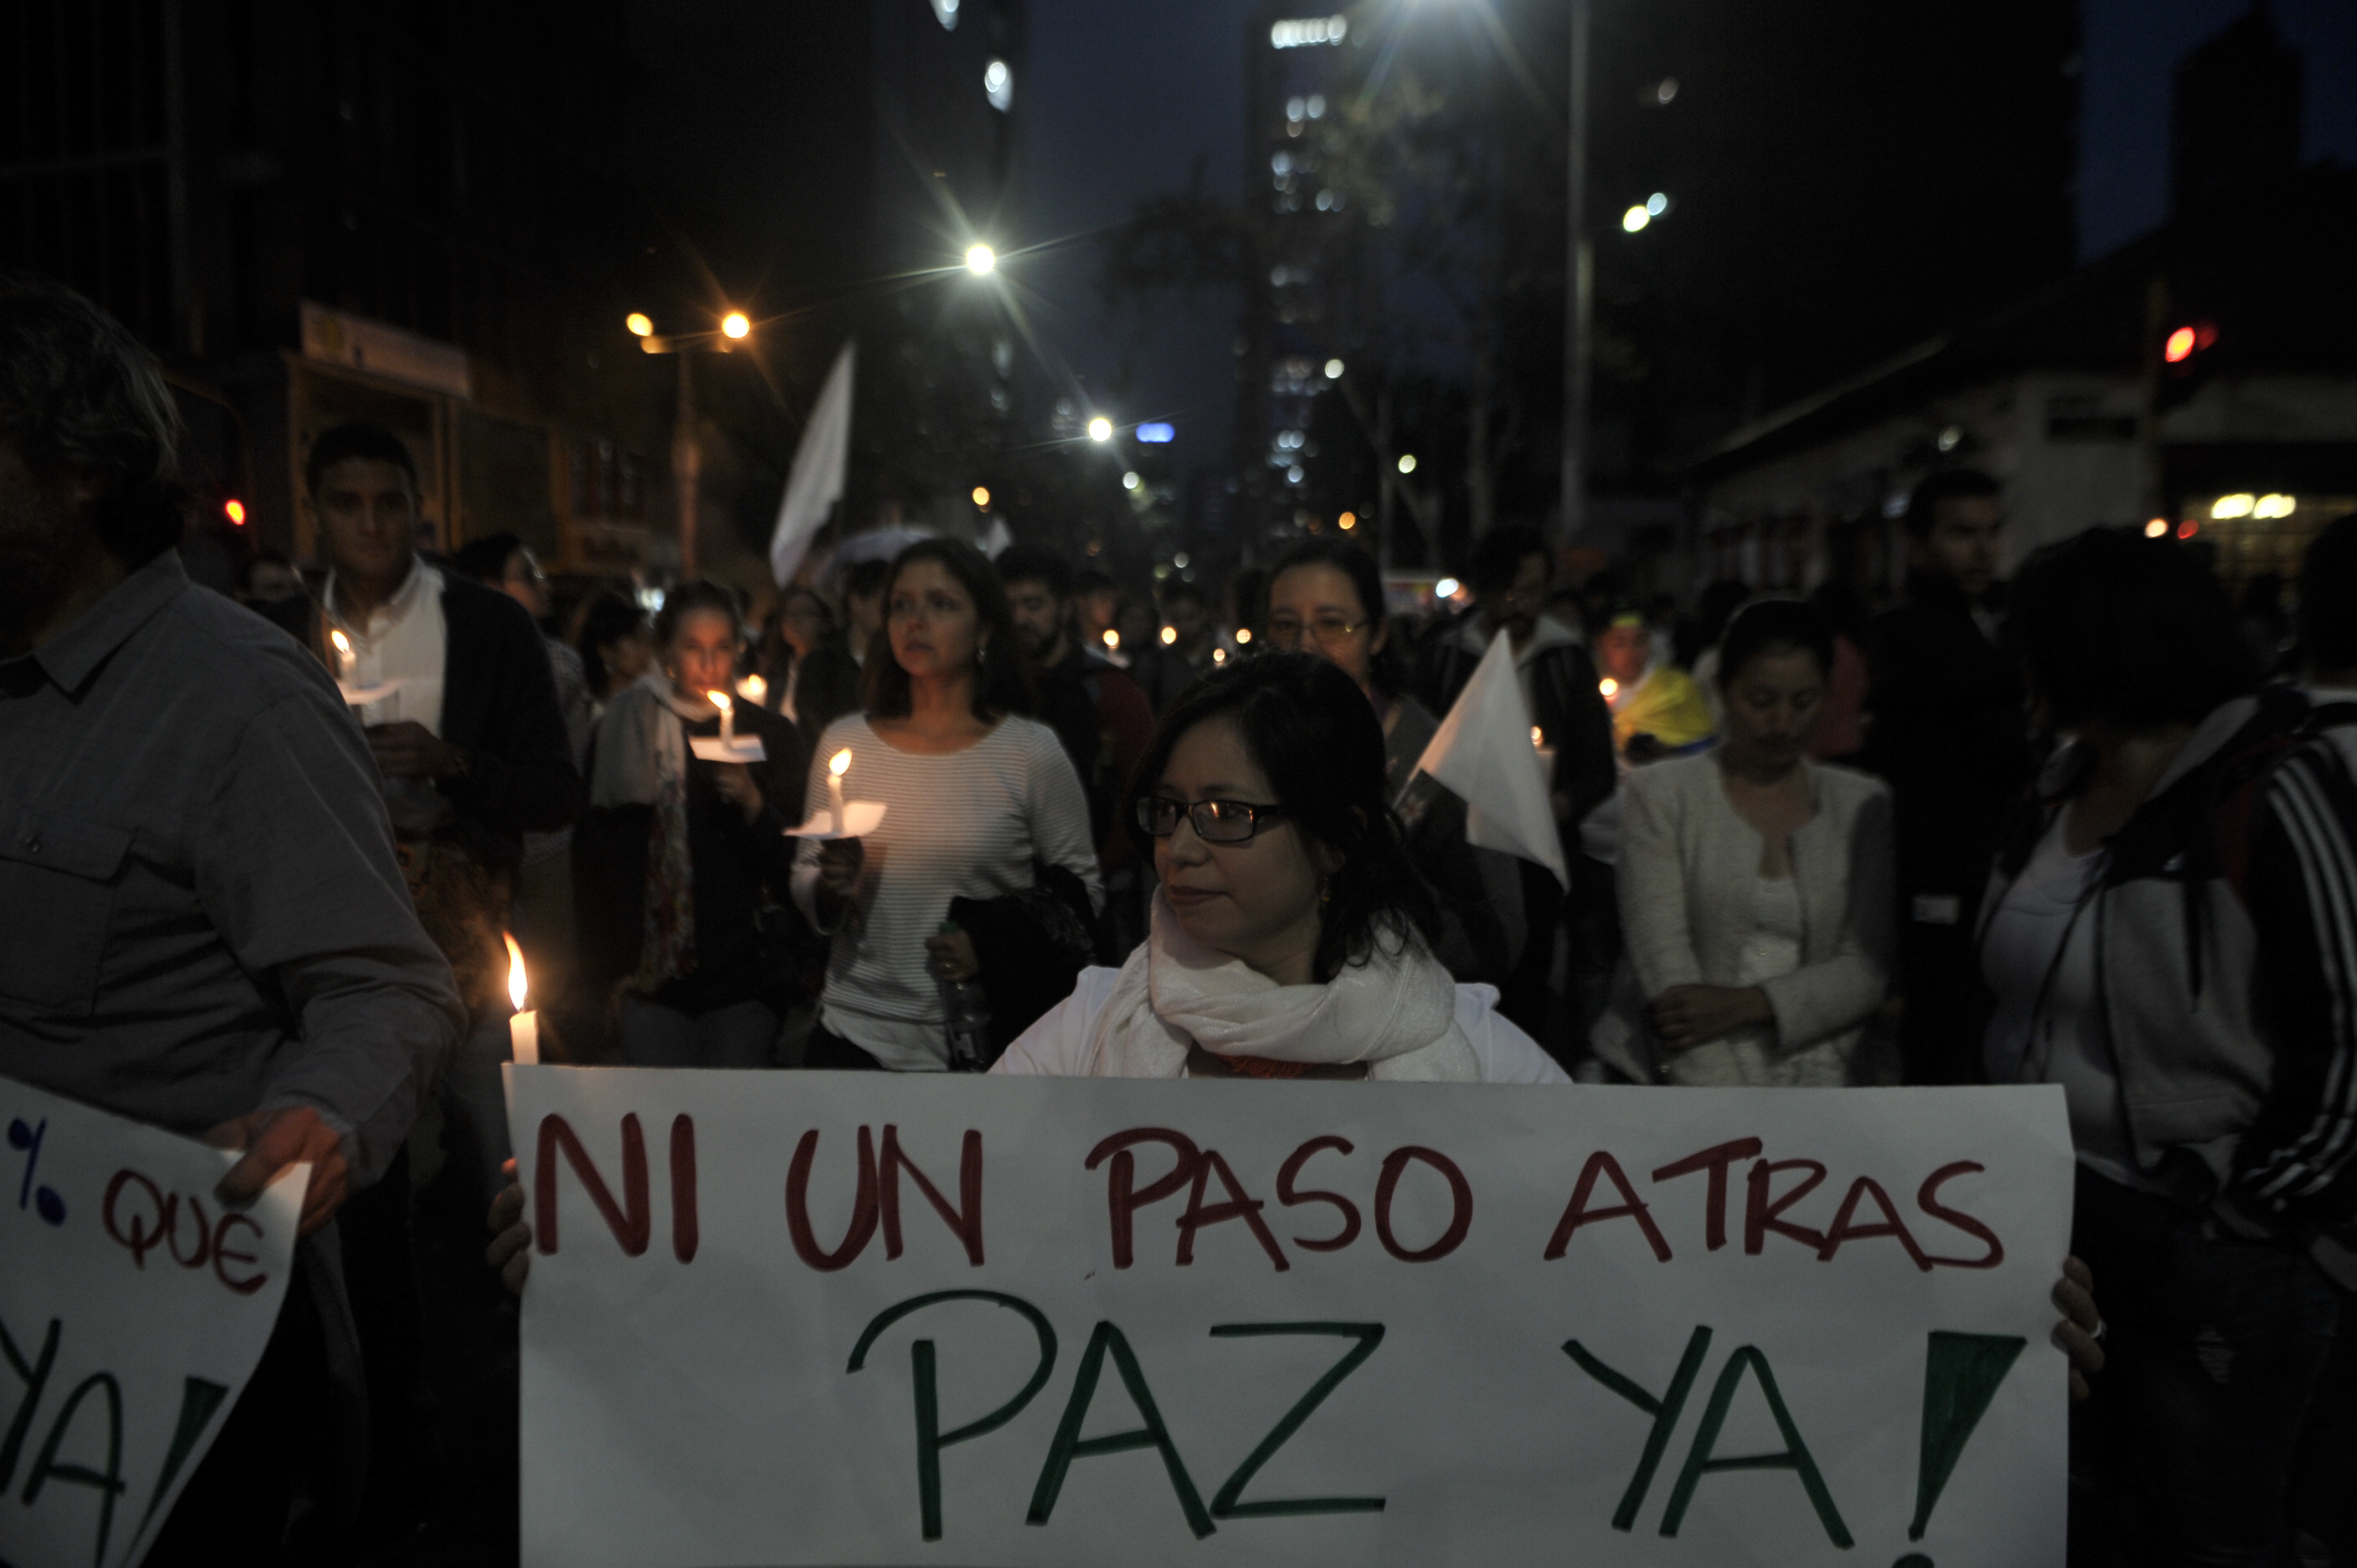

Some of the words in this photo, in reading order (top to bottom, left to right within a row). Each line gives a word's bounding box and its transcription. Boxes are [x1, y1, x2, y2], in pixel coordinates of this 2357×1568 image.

[103, 1168, 267, 1296] QUE
[534, 1112, 698, 1265] NI
[785, 1124, 985, 1272] UN
[1084, 1127, 1474, 1272] PASO
[1543, 1136, 2004, 1272] ATRAS
[846, 1289, 1387, 1540] PAZ
[1560, 1324, 2028, 1568] YA!
